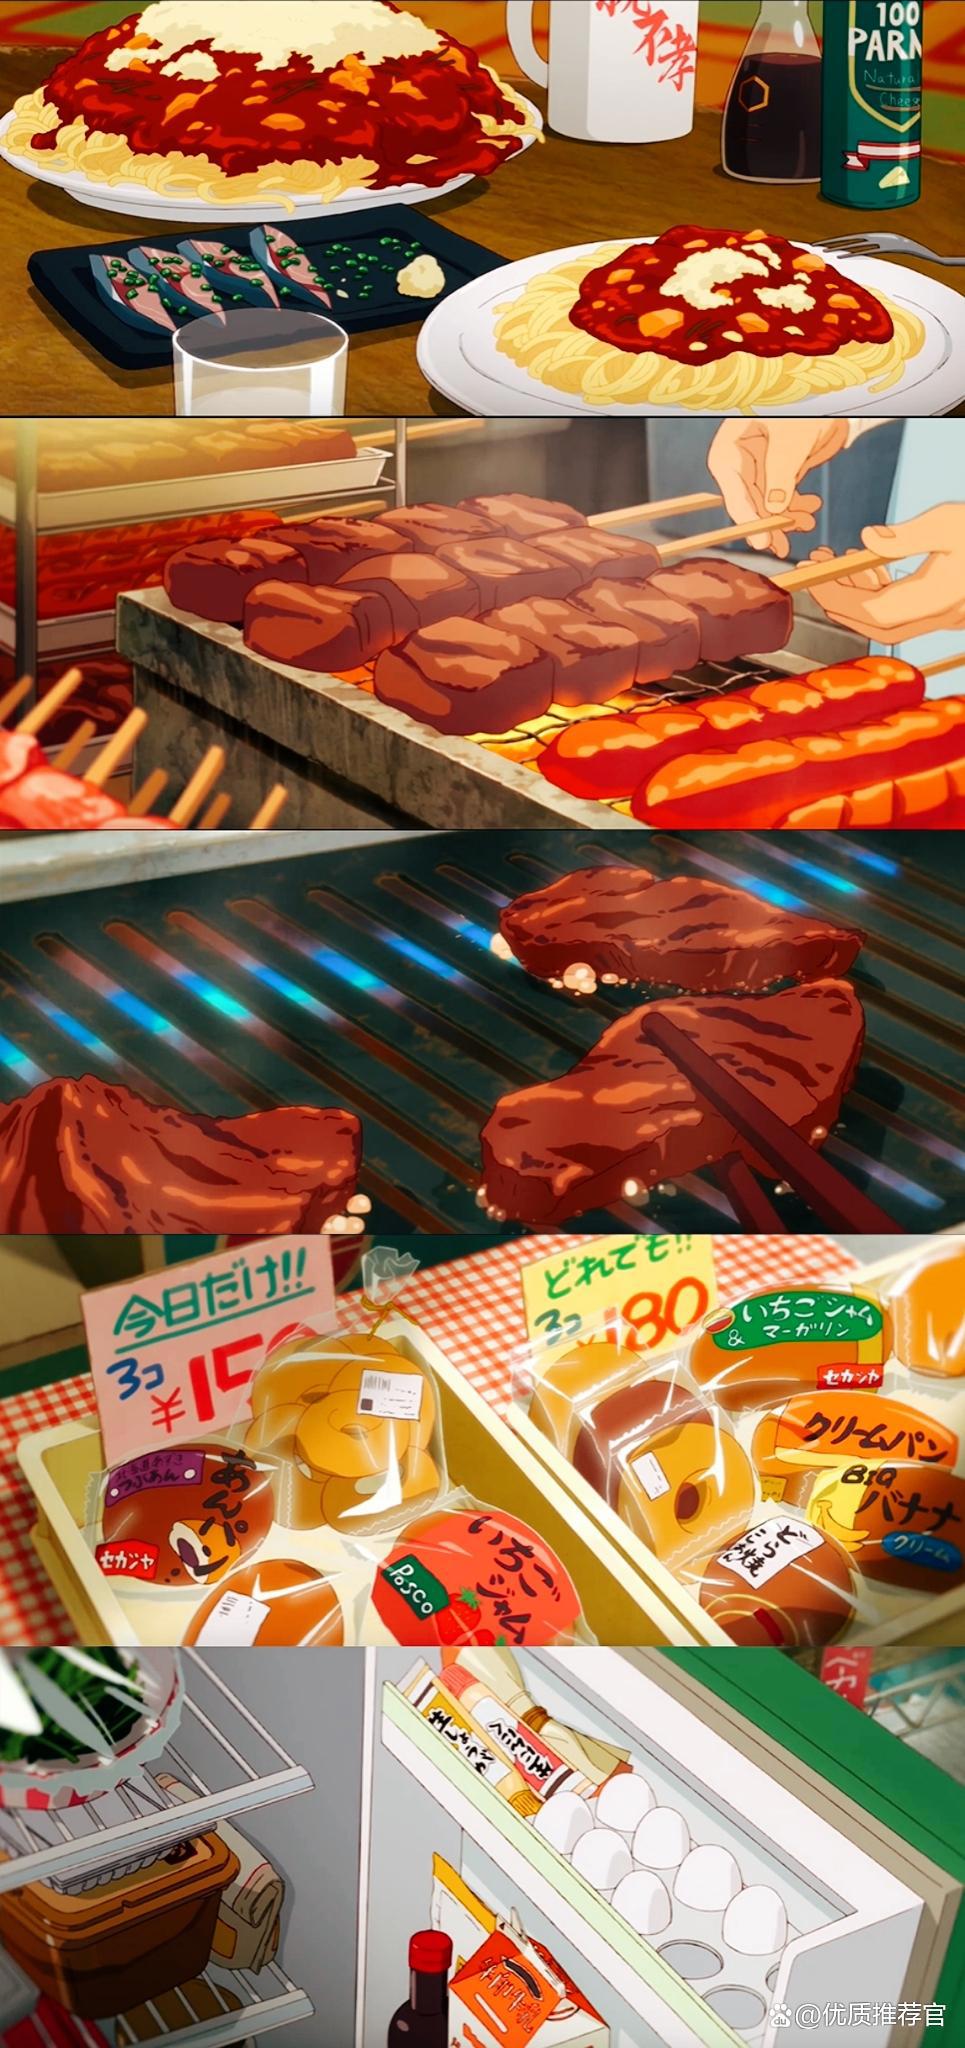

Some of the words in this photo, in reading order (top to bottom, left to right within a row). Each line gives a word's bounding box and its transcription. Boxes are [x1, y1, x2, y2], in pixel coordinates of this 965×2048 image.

[876, 1, 919, 27] 100
[113, 1247, 306, 1338] 今日だけ!!
[728, 1329, 745, 1346] &
[763, 1322, 849, 1338] マーガリン
[106, 1358, 164, 1400] 3コ
[151, 1322, 318, 1433] ¥15
[804, 1412, 949, 1462] クリームパン
[855, 1491, 961, 1533] バナナ
[467, 1516, 560, 1602] いちご
